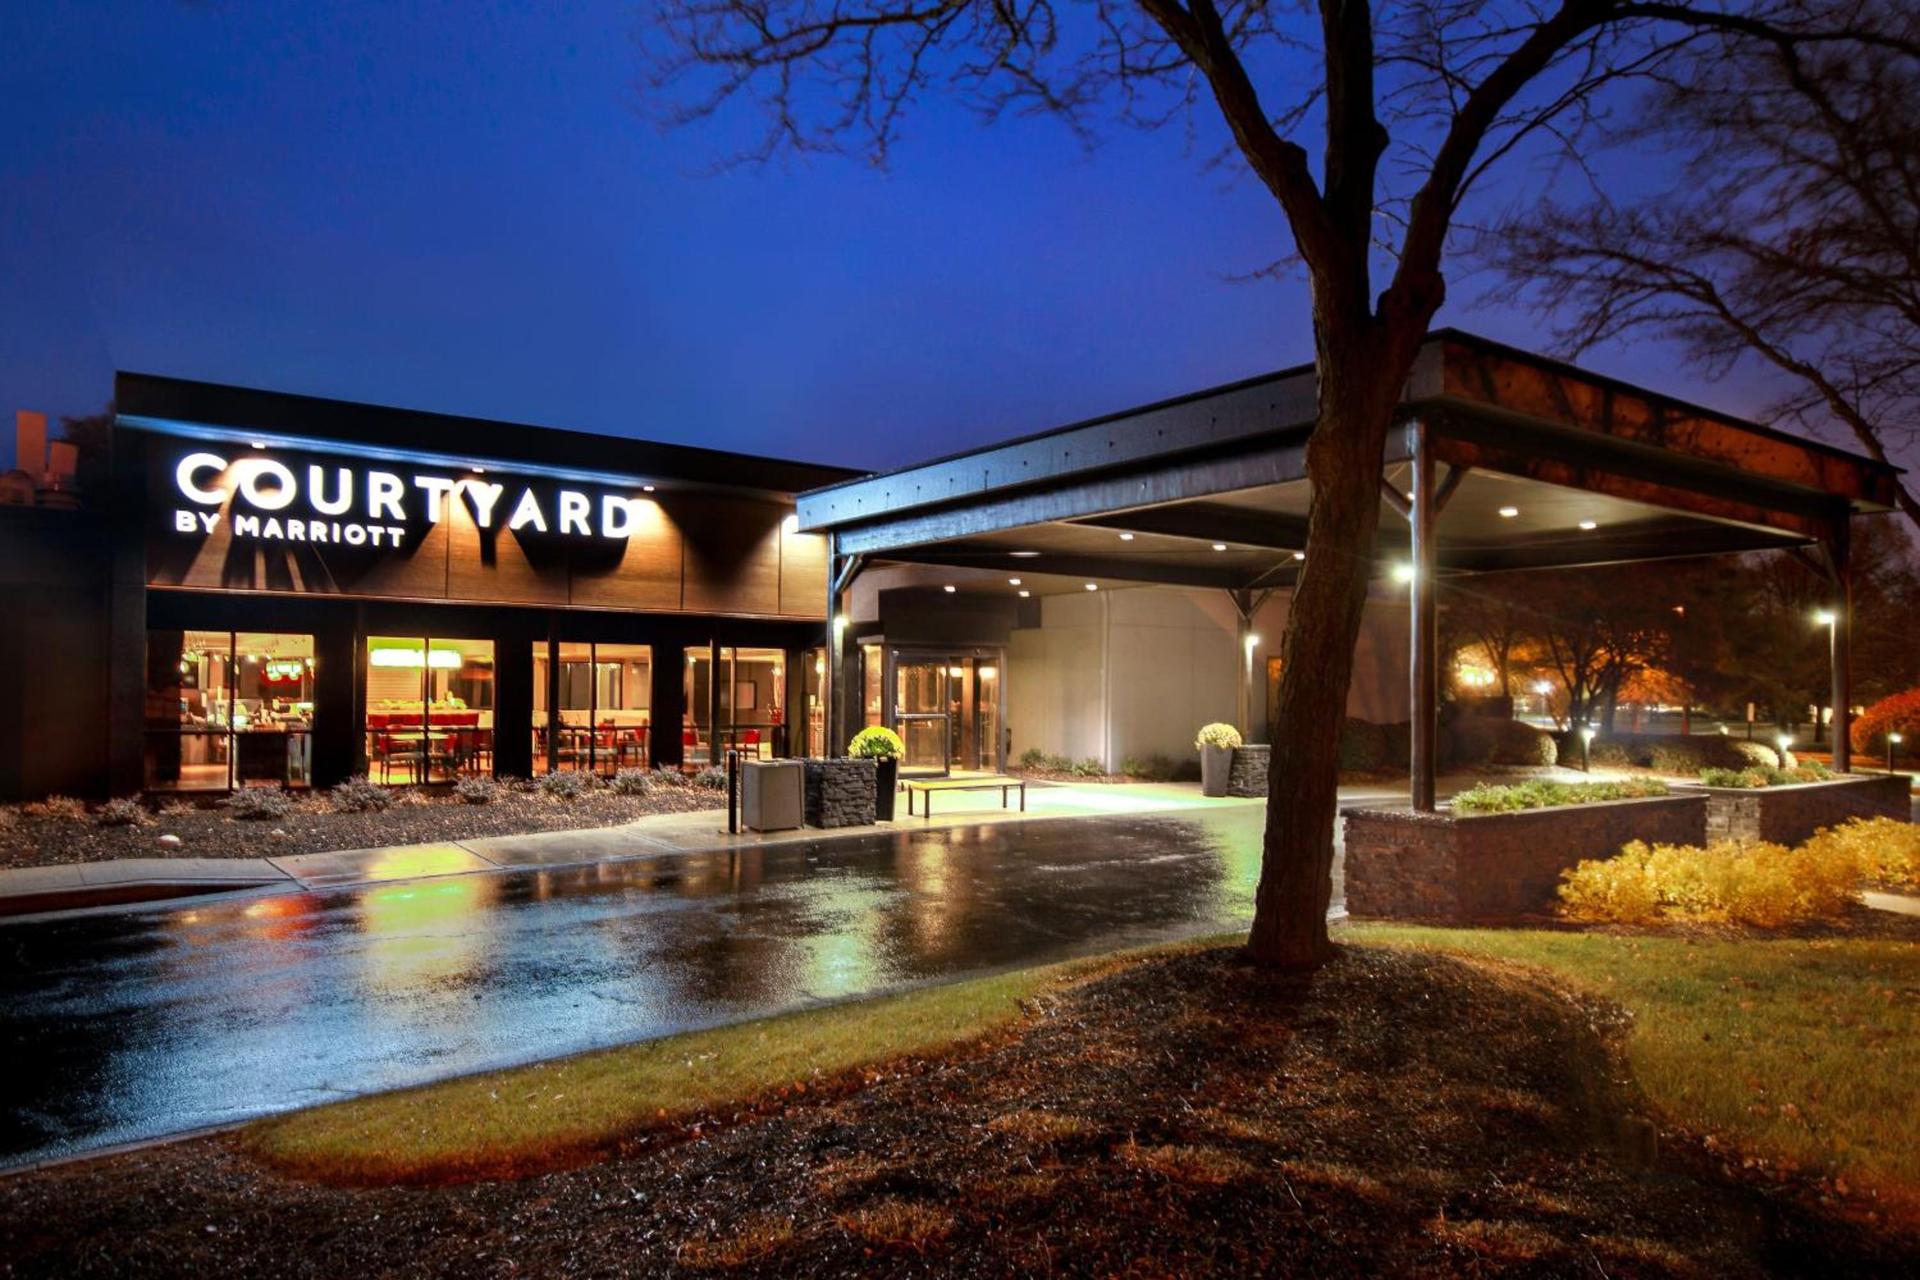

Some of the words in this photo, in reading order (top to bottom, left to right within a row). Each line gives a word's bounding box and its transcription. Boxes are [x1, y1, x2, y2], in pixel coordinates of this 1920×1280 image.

[176, 453, 633, 538] COURTYARD
[176, 511, 220, 533] BY
[236, 516, 405, 547] MARRIOTT
